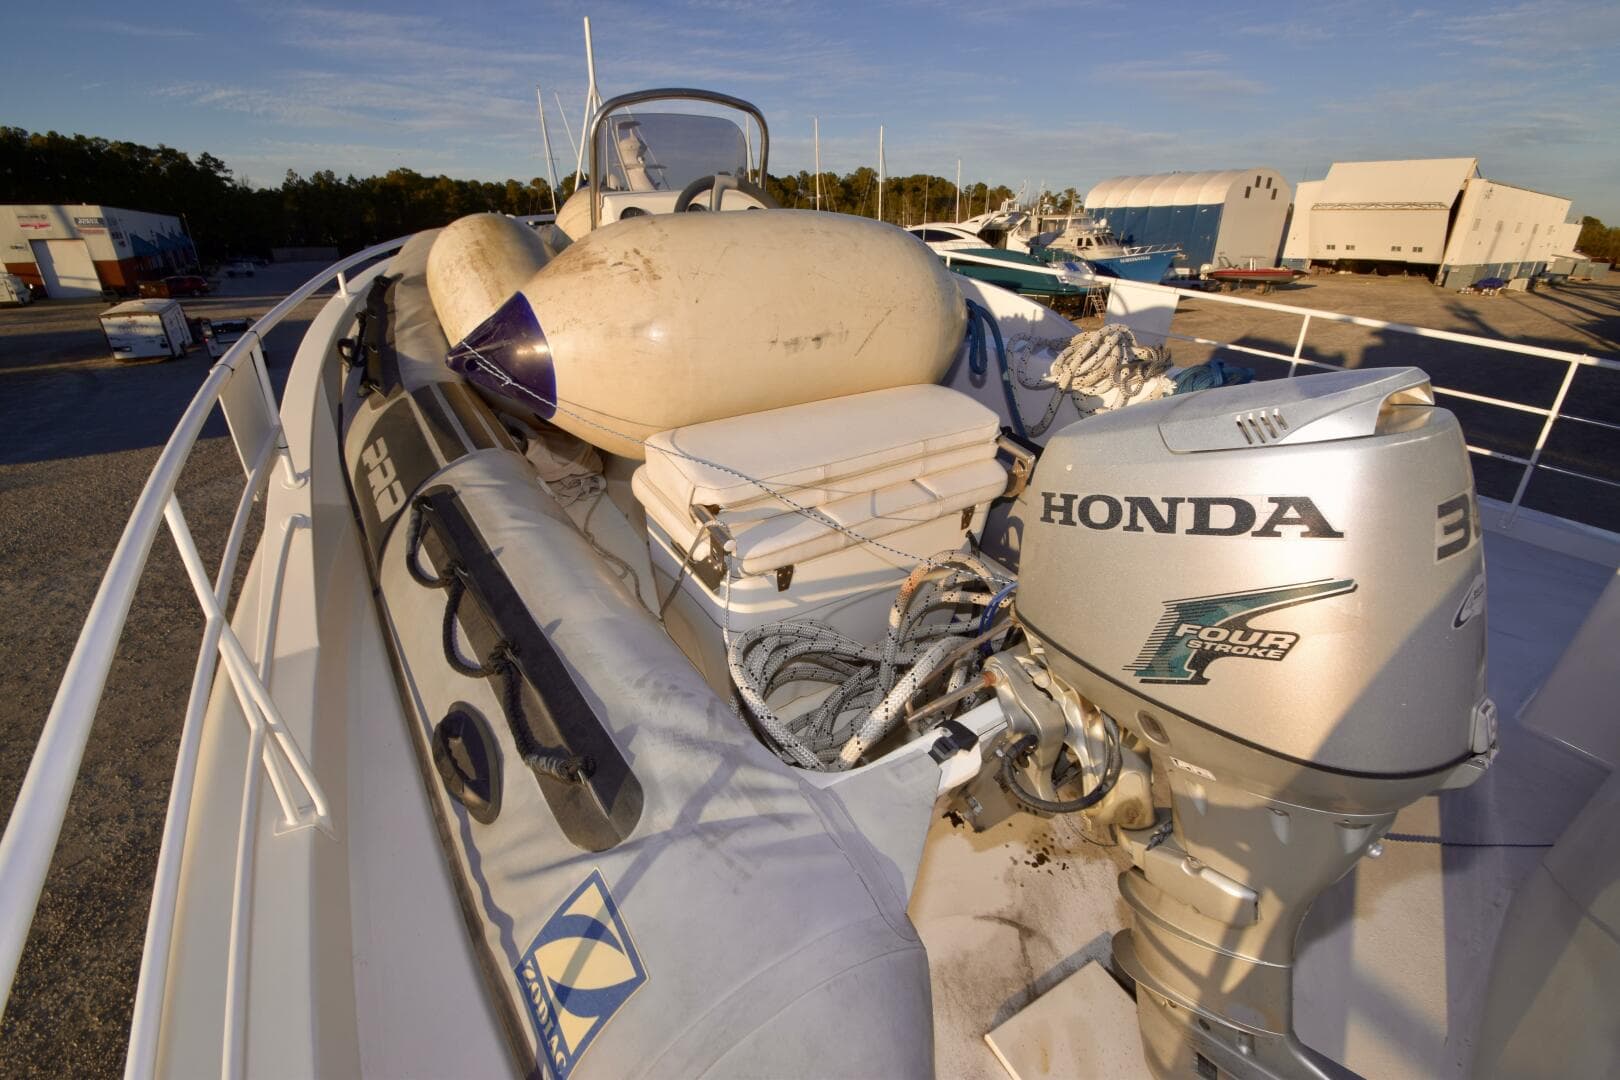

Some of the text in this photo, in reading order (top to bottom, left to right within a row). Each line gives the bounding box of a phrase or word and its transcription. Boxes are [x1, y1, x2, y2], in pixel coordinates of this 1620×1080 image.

[1040, 491, 1345, 539] HONDA
[1437, 493, 1481, 560] 3
[1175, 623, 1297, 650] FOUR
[1187, 640, 1286, 659] STROKE
[522, 959, 567, 1075] ZODIAC
